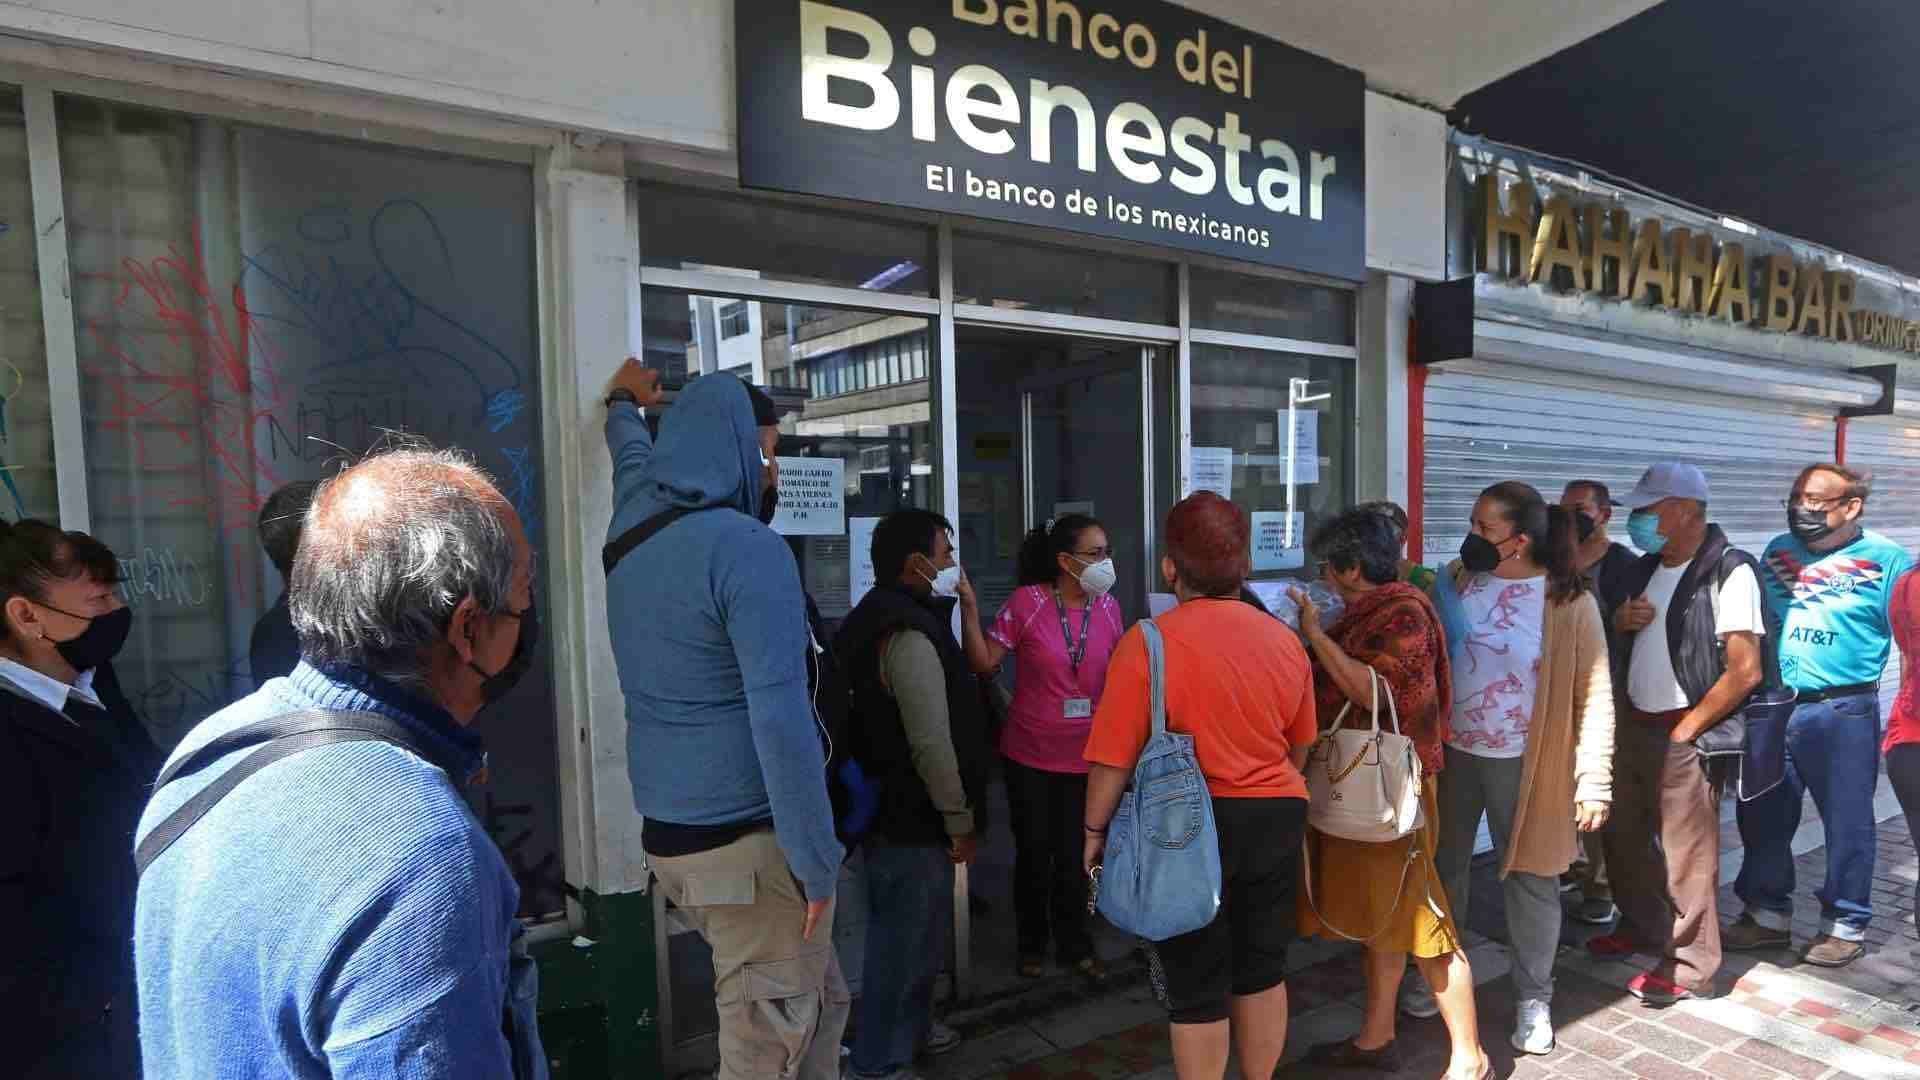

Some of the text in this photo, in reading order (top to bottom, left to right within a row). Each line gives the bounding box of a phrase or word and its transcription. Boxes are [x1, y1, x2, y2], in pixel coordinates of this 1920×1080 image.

[1175, 29, 1252, 98] del
[800, 0, 1337, 221] Bienestar
[926, 164, 1270, 248] El banco de los mexicanos
[1478, 172, 1857, 342] HAHAHA BAR
[1789, 626, 1840, 646] AT&T
